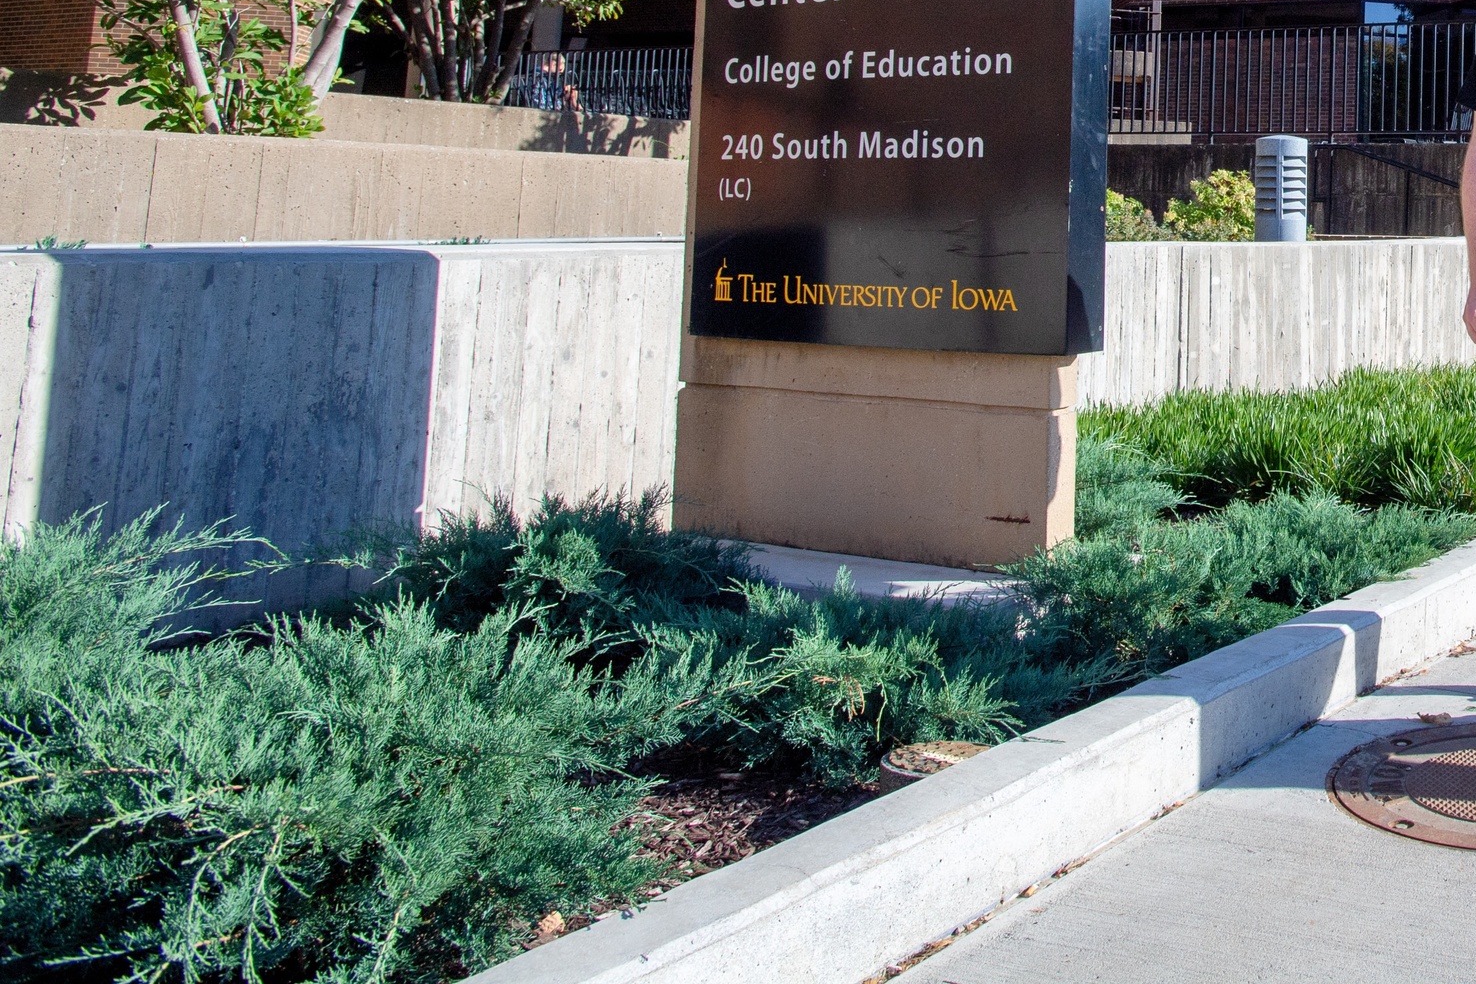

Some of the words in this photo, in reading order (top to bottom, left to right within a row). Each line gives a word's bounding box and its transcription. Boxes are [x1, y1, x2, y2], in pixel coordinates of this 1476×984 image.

[724, 55, 816, 89] College
[825, 50, 854, 80] of
[862, 47, 1013, 79] Education
[721, 133, 763, 160] 240
[771, 130, 848, 160] South
[858, 129, 985, 159] Madison
[719, 177, 751, 201] (LC)
[737, 273, 777, 303] THE
[783, 275, 908, 308] UNIVERSITY
[911, 286, 943, 309] OF
[951, 279, 1018, 312] IOWA
